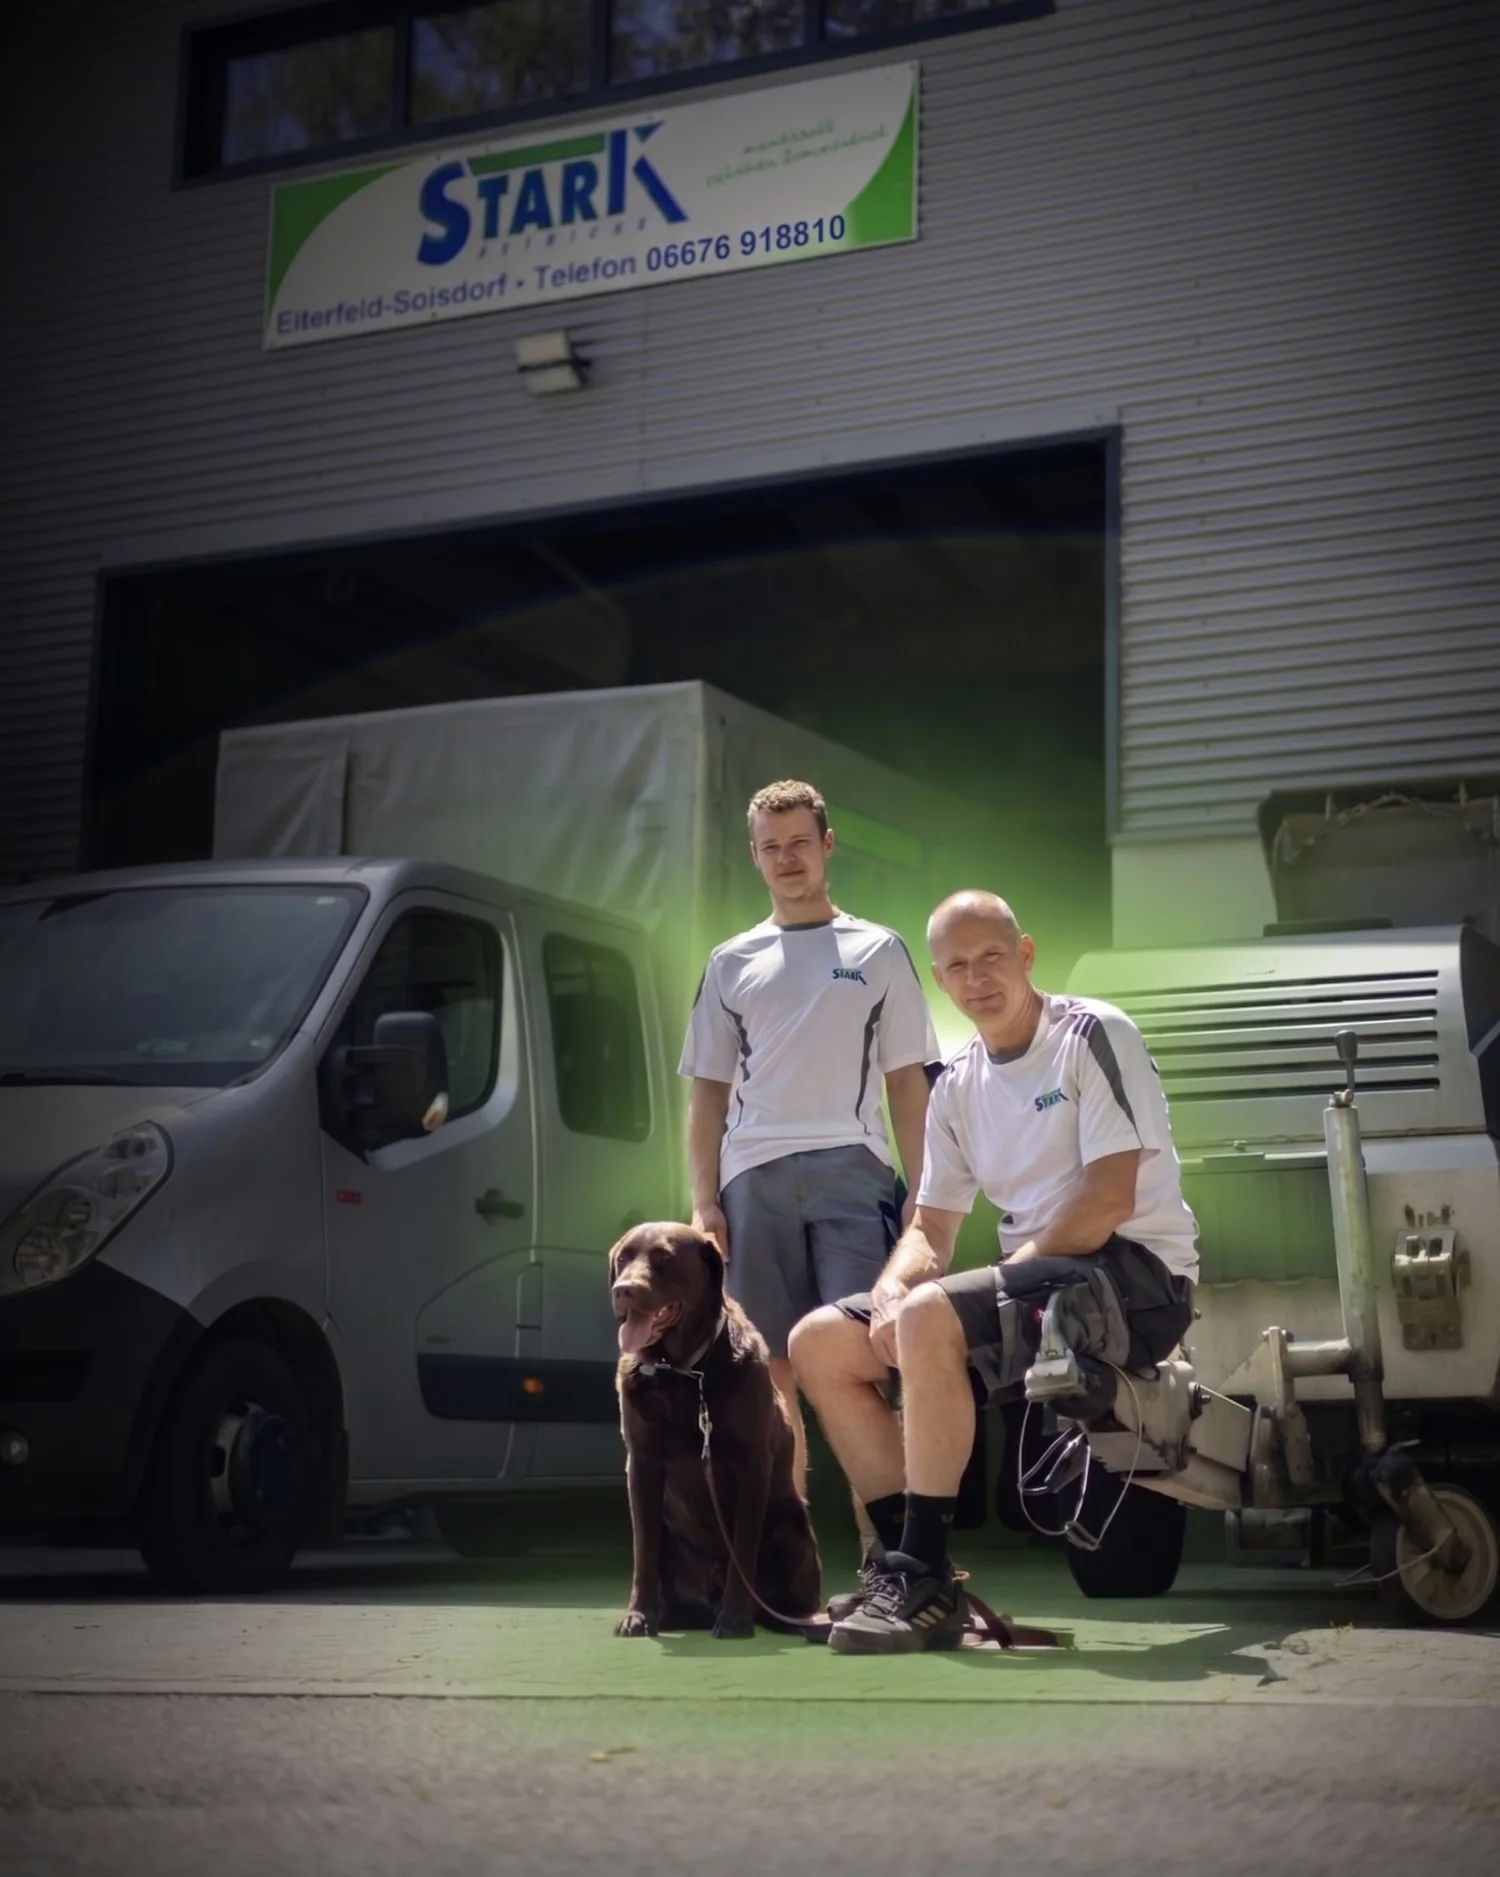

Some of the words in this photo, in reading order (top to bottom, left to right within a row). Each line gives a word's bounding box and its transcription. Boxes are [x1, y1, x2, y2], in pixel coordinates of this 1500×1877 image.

[417, 120, 689, 265] STARK
[277, 275, 510, 334] Eiterfeld-Soisdorf
[535, 253, 637, 291] Telefon
[646, 236, 730, 272] 06676
[740, 214, 846, 256] 918810
